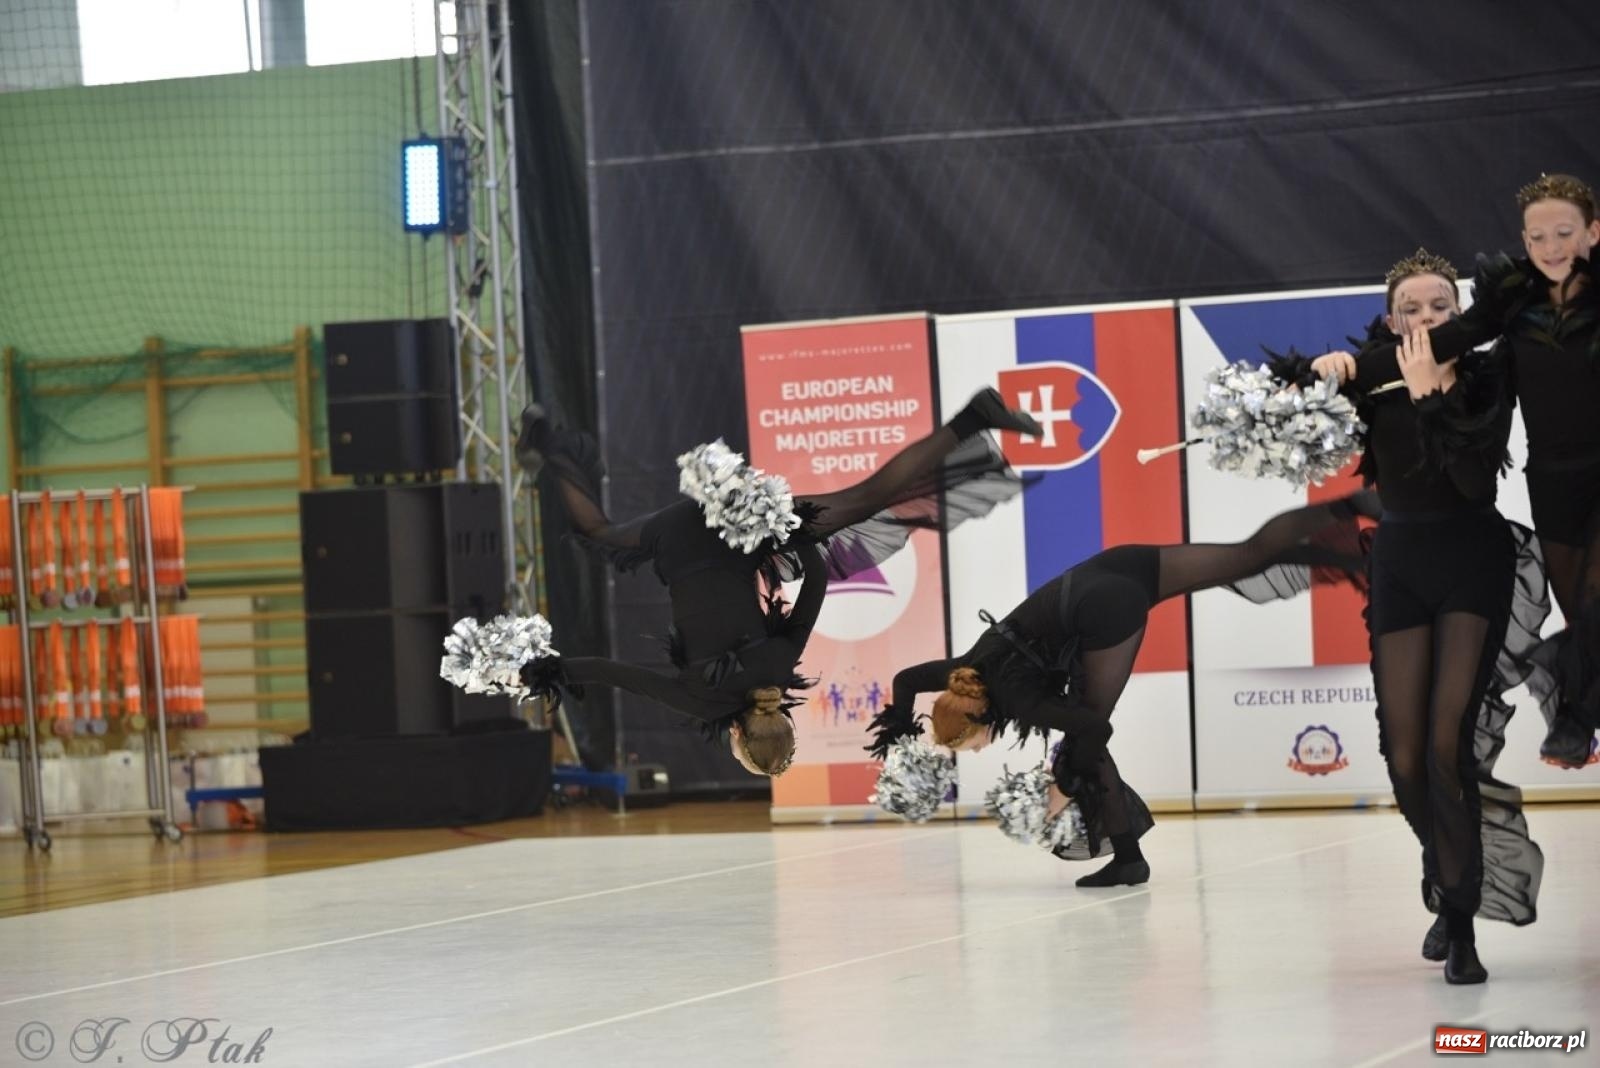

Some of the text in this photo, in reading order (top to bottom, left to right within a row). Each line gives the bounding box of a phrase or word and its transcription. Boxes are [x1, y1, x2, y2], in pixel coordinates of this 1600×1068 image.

[781, 375, 894, 401] EUROPEAN
[759, 399, 920, 428] CHAMPIONSHIP
[775, 425, 906, 453] MAJORETTES
[811, 453, 878, 475] SPORT
[1234, 687, 1376, 706] CZECH REPUBL
